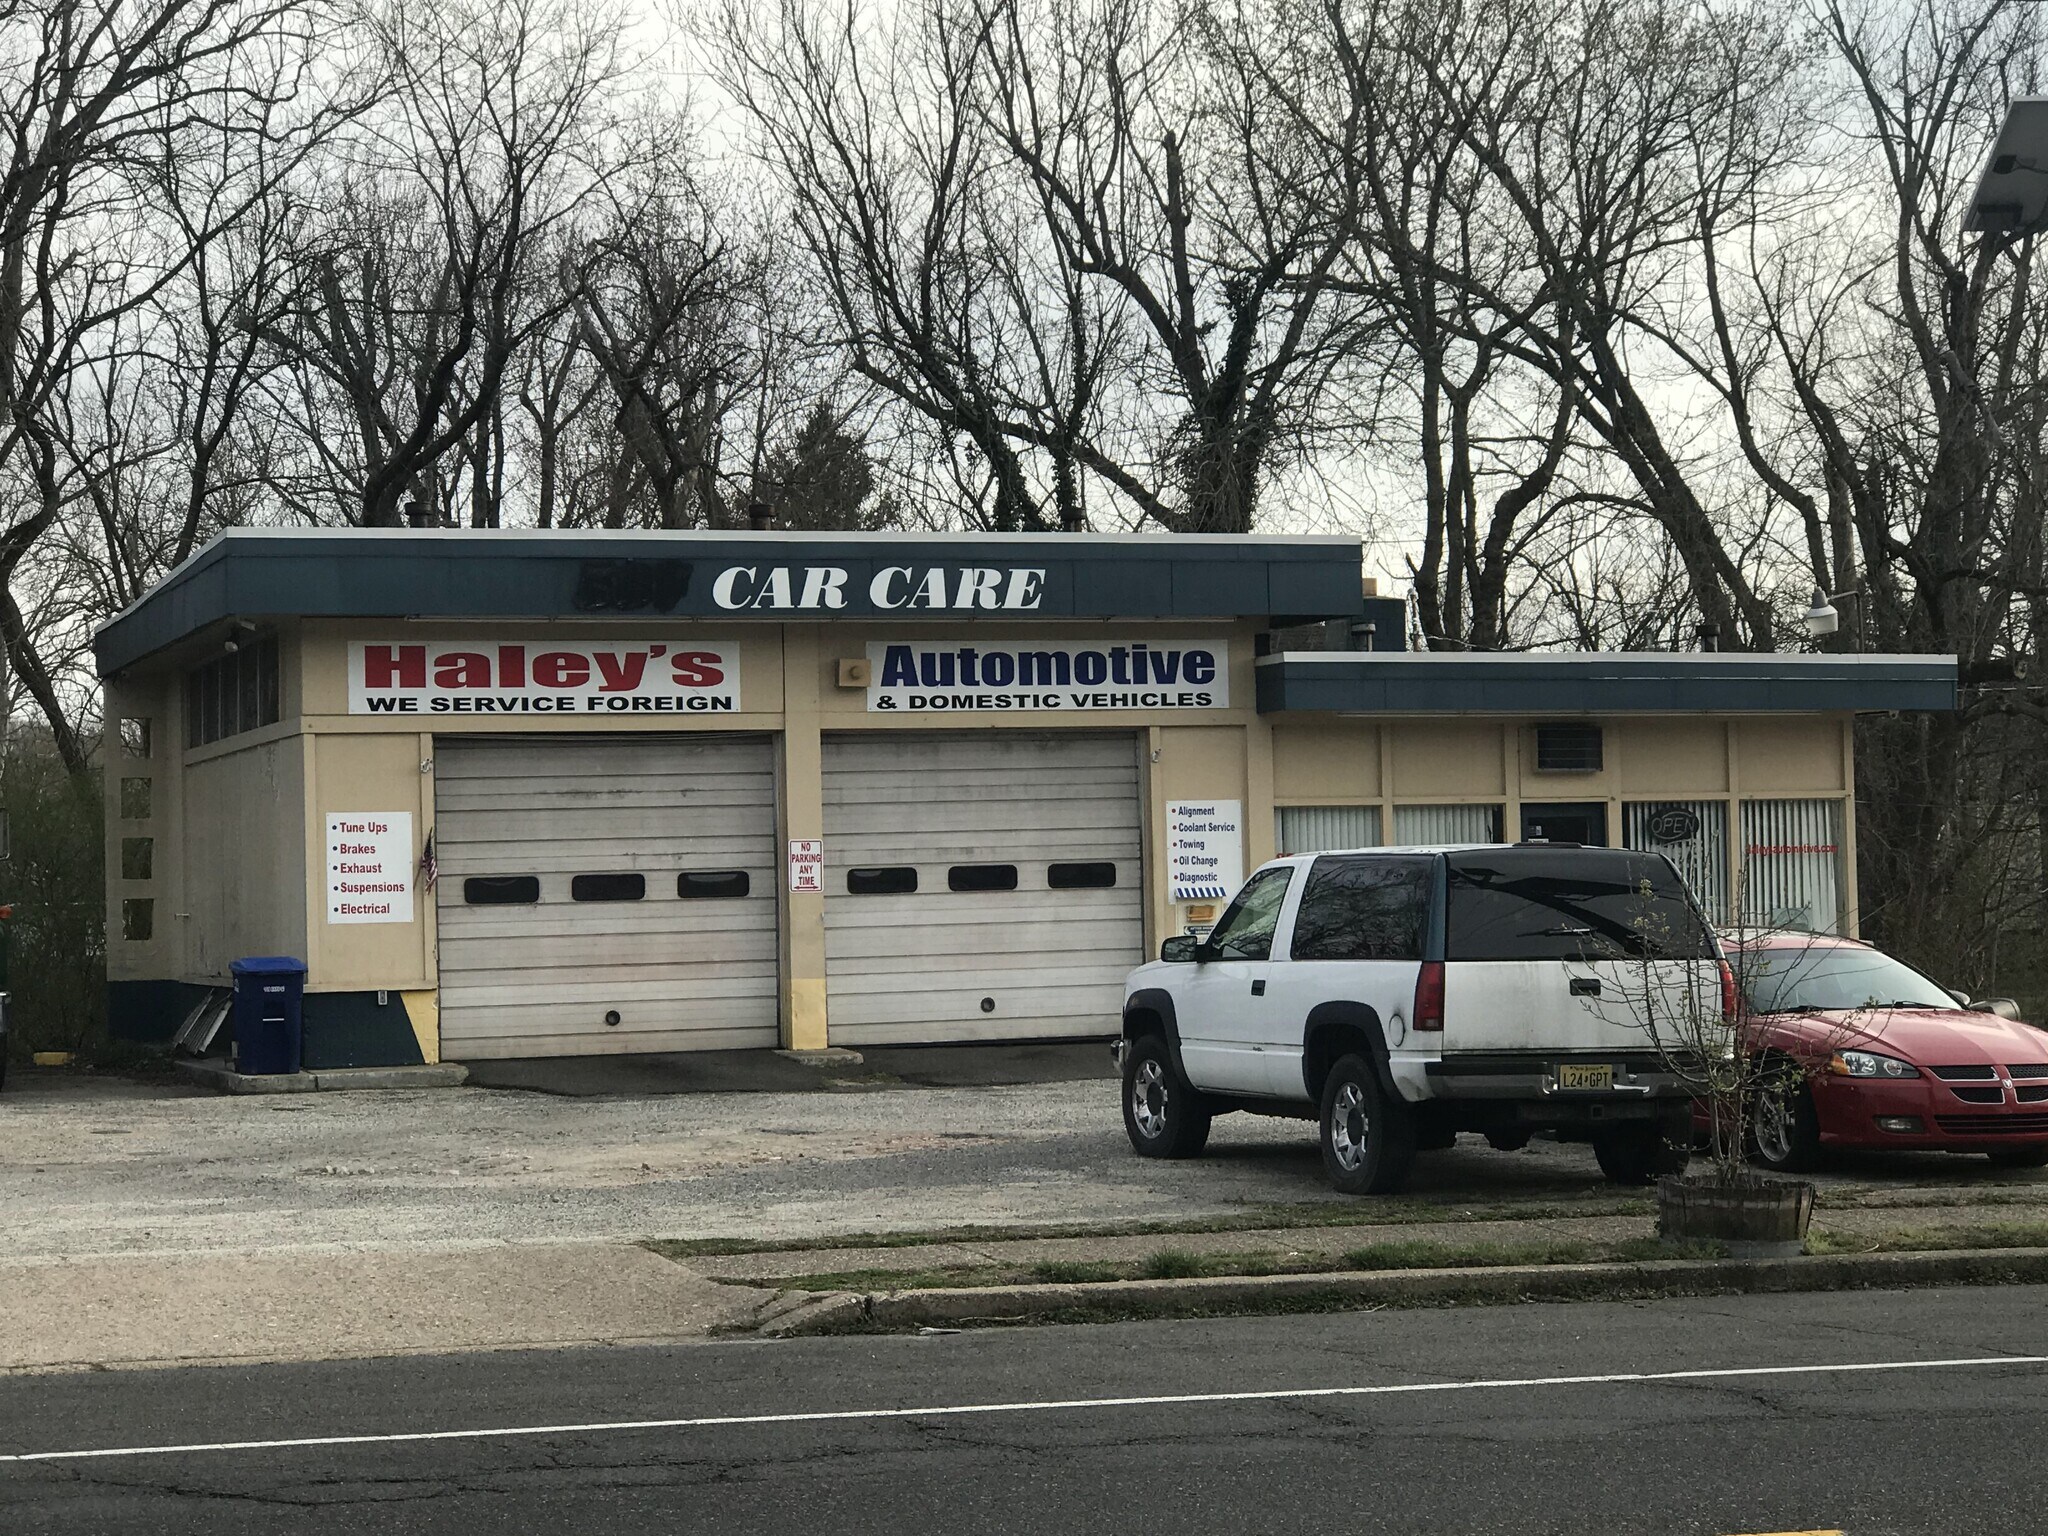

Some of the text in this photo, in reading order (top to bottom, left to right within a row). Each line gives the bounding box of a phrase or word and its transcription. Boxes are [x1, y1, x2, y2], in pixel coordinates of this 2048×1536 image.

[712, 566, 1047, 610] CAR CARE
[364, 645, 725, 692] Haley's
[880, 644, 1216, 688] Automotive
[366, 696, 732, 712] WE SERVICE FOREIGN
[876, 692, 1213, 710] & DOMESTIC VEHICLES
[1178, 806, 1215, 818] Alignment
[340, 822, 388, 834] Tune Ups
[1178, 822, 1236, 832] Coolant Service
[1651, 817, 1696, 834] OPEN
[340, 843, 376, 854] Brakes
[801, 843, 811, 852] NO
[1179, 839, 1205, 850] Towing
[792, 854, 821, 862] PARKING
[1179, 856, 1218, 867] Oil Change
[340, 863, 382, 874] Exhaust
[799, 865, 813, 874] ANY
[799, 877, 814, 885] TIME
[1179, 872, 1218, 883] Diagnostic
[340, 881, 405, 895] Suspensions
[340, 903, 390, 915] Electrical
